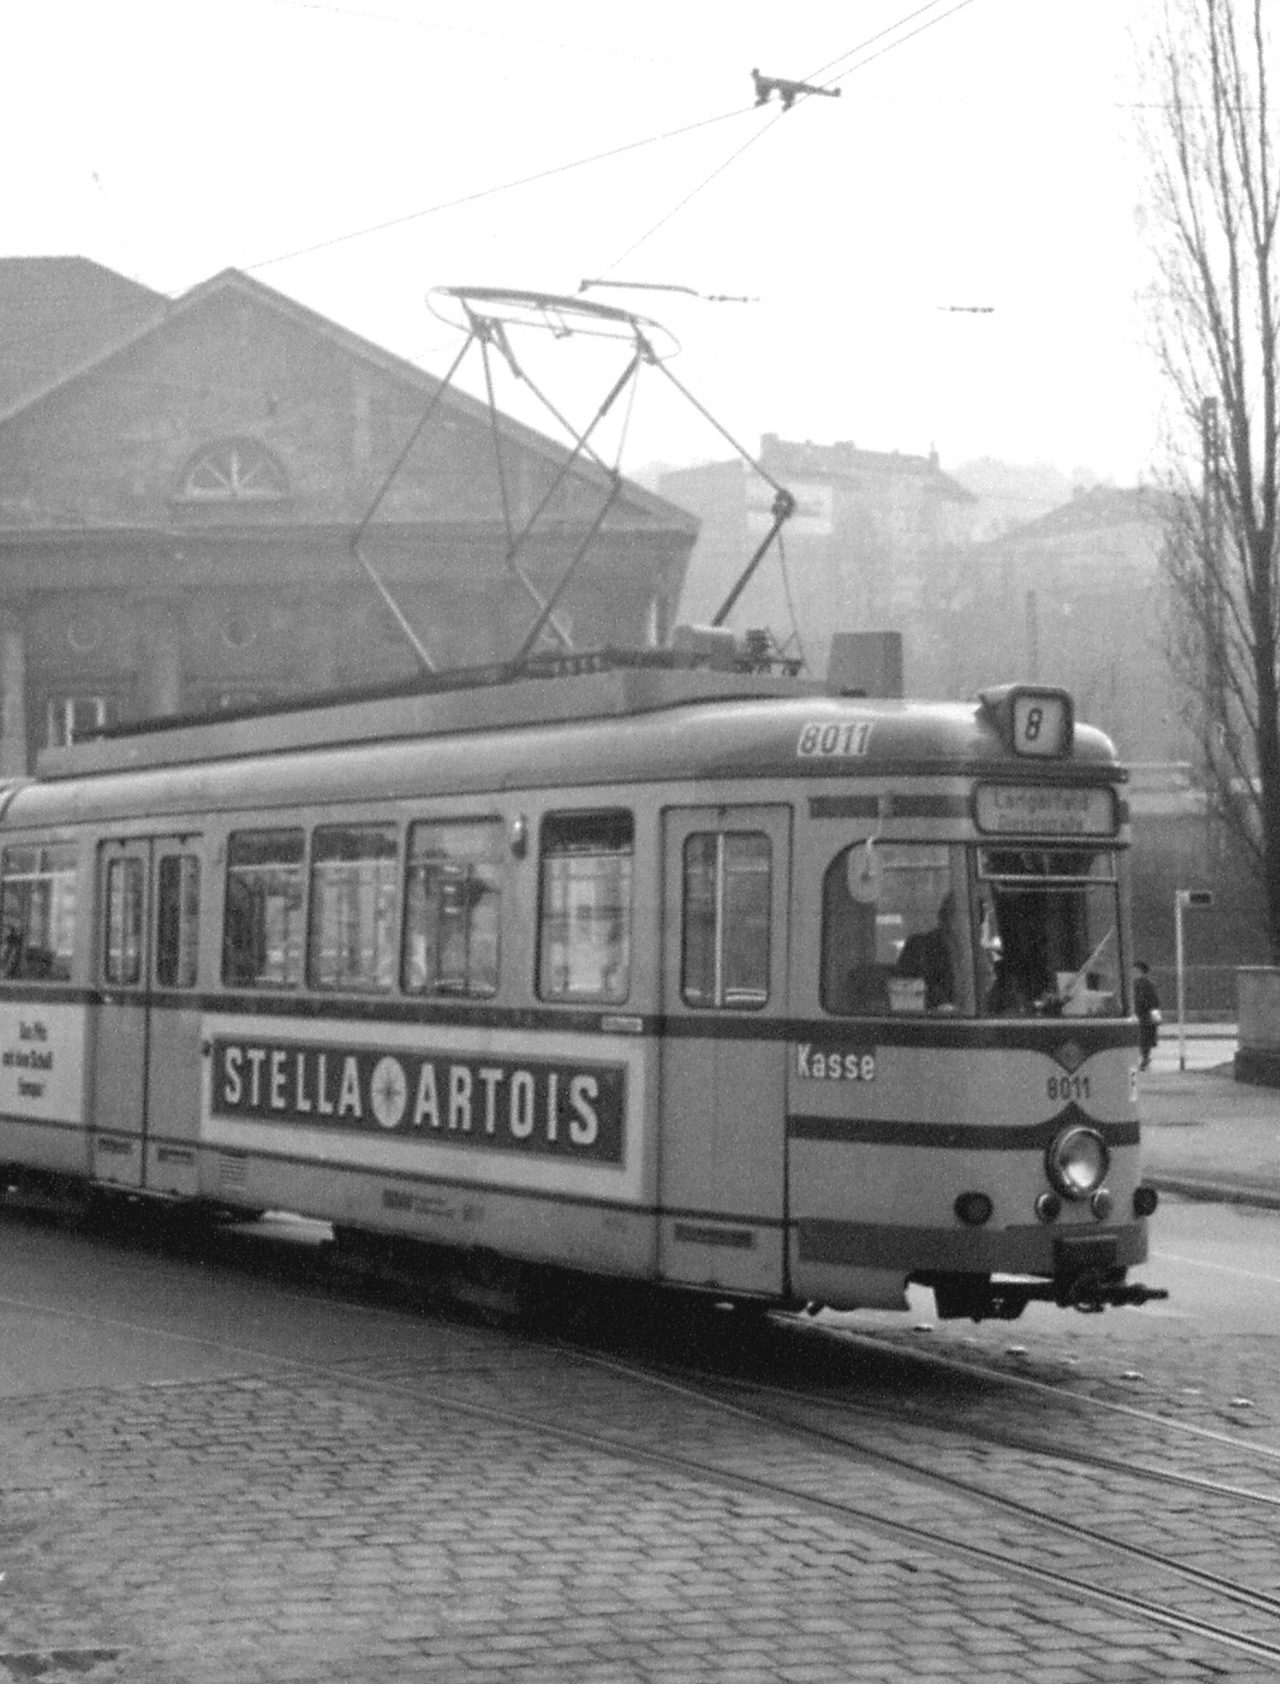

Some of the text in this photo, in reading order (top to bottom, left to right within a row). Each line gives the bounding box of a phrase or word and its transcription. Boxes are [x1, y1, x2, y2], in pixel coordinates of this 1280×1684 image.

[799, 721, 871, 755] 8011
[1024, 707, 1043, 741] 8
[798, 1043, 875, 1080] Kasse
[224, 1046, 599, 1145] STELLA ARTOIS
[1047, 1077, 1091, 1100] 8011
